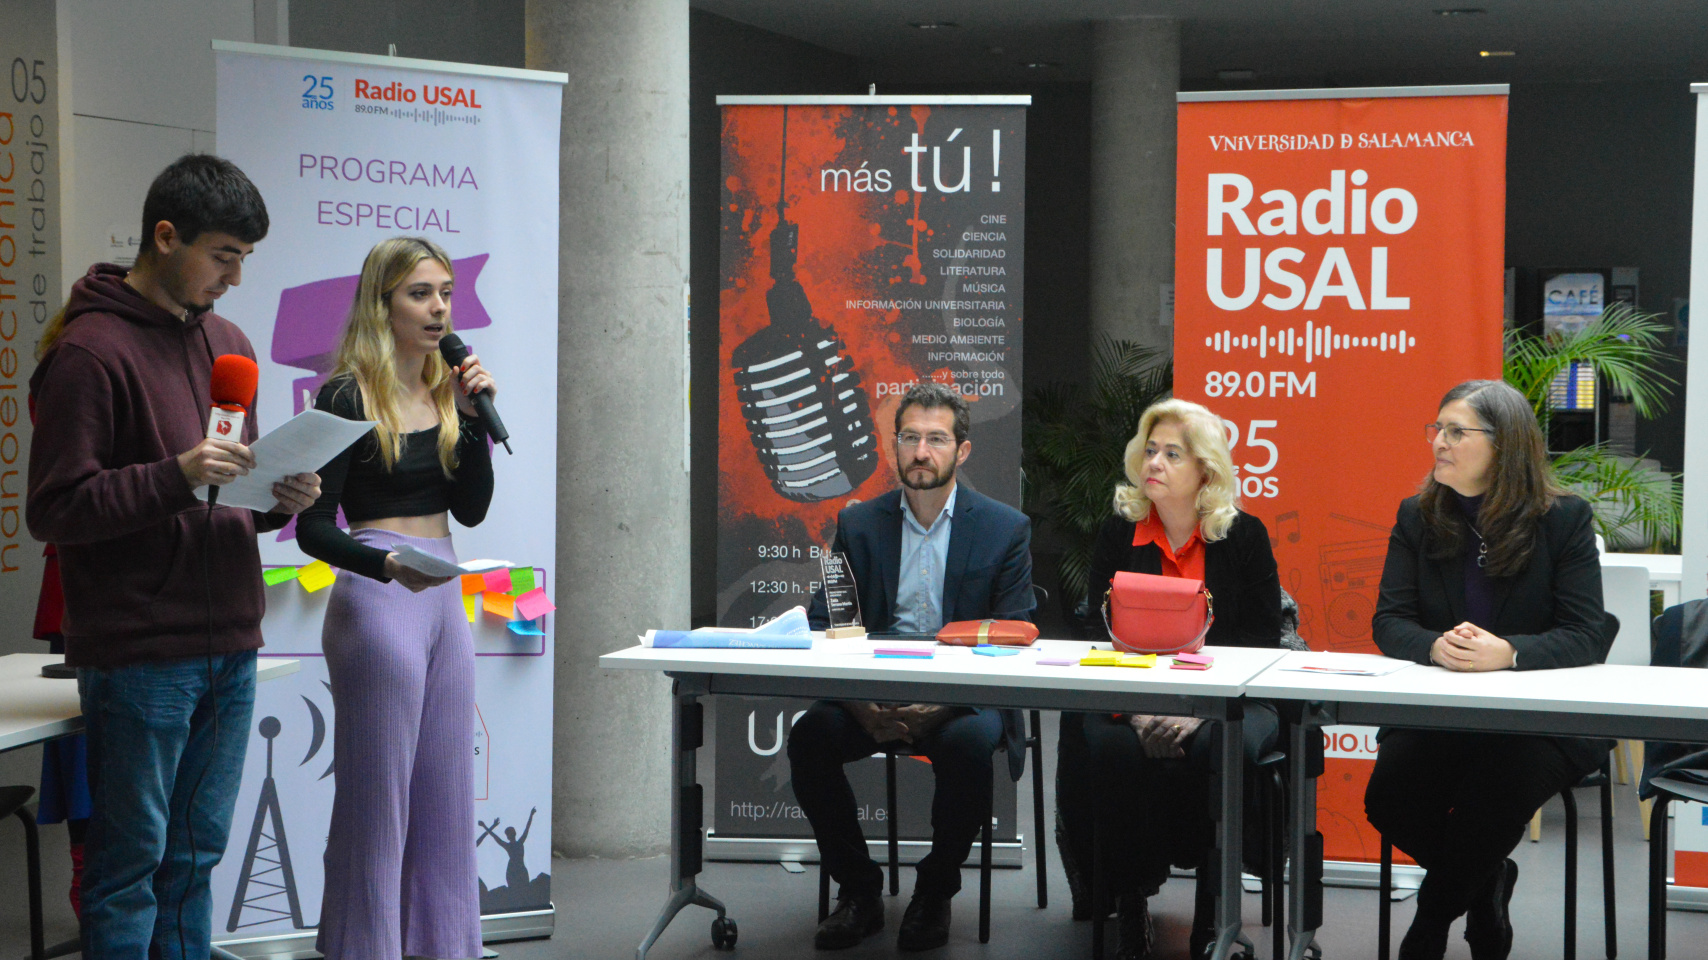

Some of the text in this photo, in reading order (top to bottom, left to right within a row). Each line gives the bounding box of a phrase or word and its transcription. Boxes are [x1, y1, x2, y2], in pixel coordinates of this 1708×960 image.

[11, 57, 47, 105] 05
[302, 75, 334, 100] 25
[354, 78, 482, 109] Radio USAL
[1357, 131, 1475, 149] SALAMANCA
[820, 161, 893, 193] más
[903, 128, 971, 193] tú
[299, 153, 479, 191] PROGRAMA
[25, 114, 49, 255] trabajo
[1207, 168, 1418, 236] Radio
[317, 200, 461, 234] ESPECIAL
[980, 215, 1007, 225] CINE
[962, 231, 1007, 242] CIENCIA
[932, 248, 1006, 259] SOLIDARIDAD
[940, 266, 1007, 276] LITERATURA
[1206, 246, 1411, 311] USAL
[962, 282, 1006, 293] MÚSICA
[29, 272, 48, 324] de
[1547, 285, 1599, 306] CAFÉ
[845, 298, 1006, 311] INFORMACIÓN UNIVERSITARIA
[953, 315, 1006, 328] BIOLOGÍA
[911, 334, 1005, 346] MEDIO AMBIENTE
[927, 350, 1005, 362] INFORMACIÓN
[950, 370, 979, 379] sobre
[981, 370, 1005, 379] todo
[757, 545, 789, 559] 9:30
[824, 564, 844, 575] USAL
[749, 580, 788, 595] 12:30
[792, 580, 805, 594] h.
